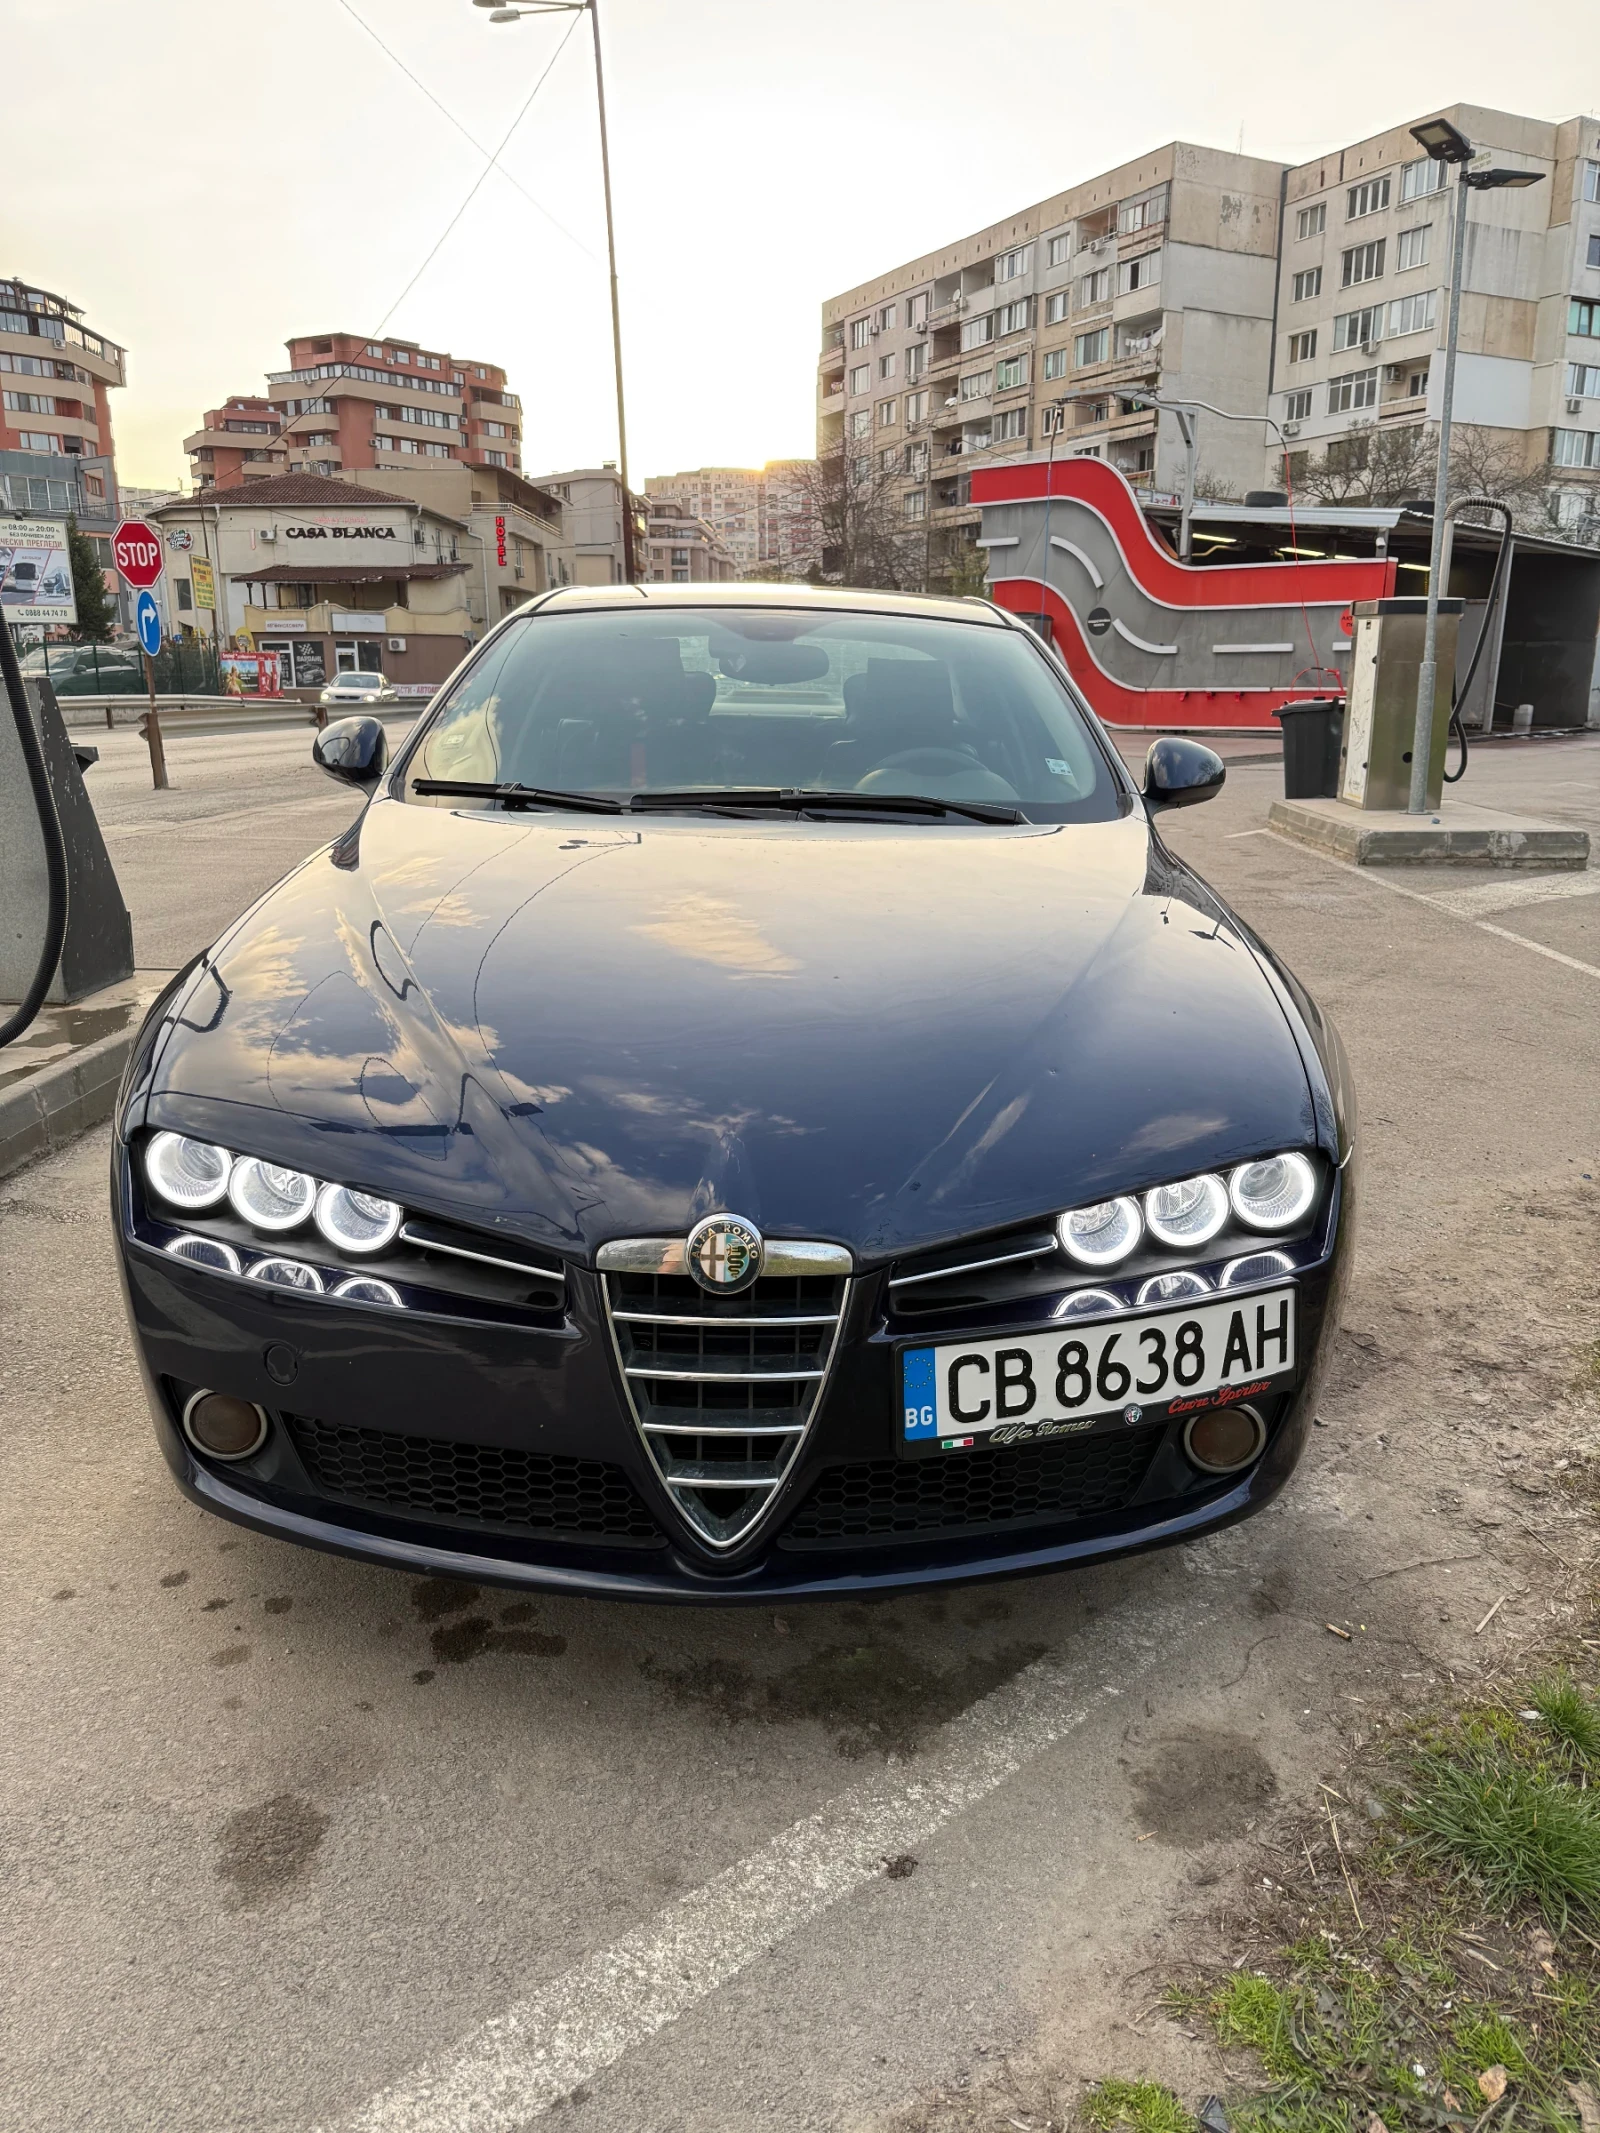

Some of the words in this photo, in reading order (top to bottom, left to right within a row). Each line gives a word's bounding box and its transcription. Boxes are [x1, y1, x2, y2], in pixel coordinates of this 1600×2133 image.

[36, 525, 55, 533] 20:00
[286, 527, 328, 539] CASA
[332, 527, 396, 539] BLANCA
[496, 516, 507, 566] HOTEL
[0, 537, 24, 547] ЧЕСКИ
[26, 539, 63, 549] ПРЕГЛЕДИ
[117, 542, 158, 567] STOP
[25, 608, 41, 617] 0888
[42, 609, 50, 617] 44
[51, 609, 59, 617] 74
[59, 609, 68, 617] 78
[692, 1227, 716, 1258] ALFA
[723, 1223, 758, 1259] ROMEO
[948, 1348, 1036, 1424] CB
[1055, 1320, 1205, 1408] 8638
[1221, 1298, 1288, 1379] AH
[1168, 1398, 1209, 1414] Cuore
[1211, 1381, 1271, 1406] Sportivo
[905, 1406, 933, 1429] BG
[989, 1424, 1034, 1444] Alfa
[1035, 1420, 1096, 1437] Romeo
